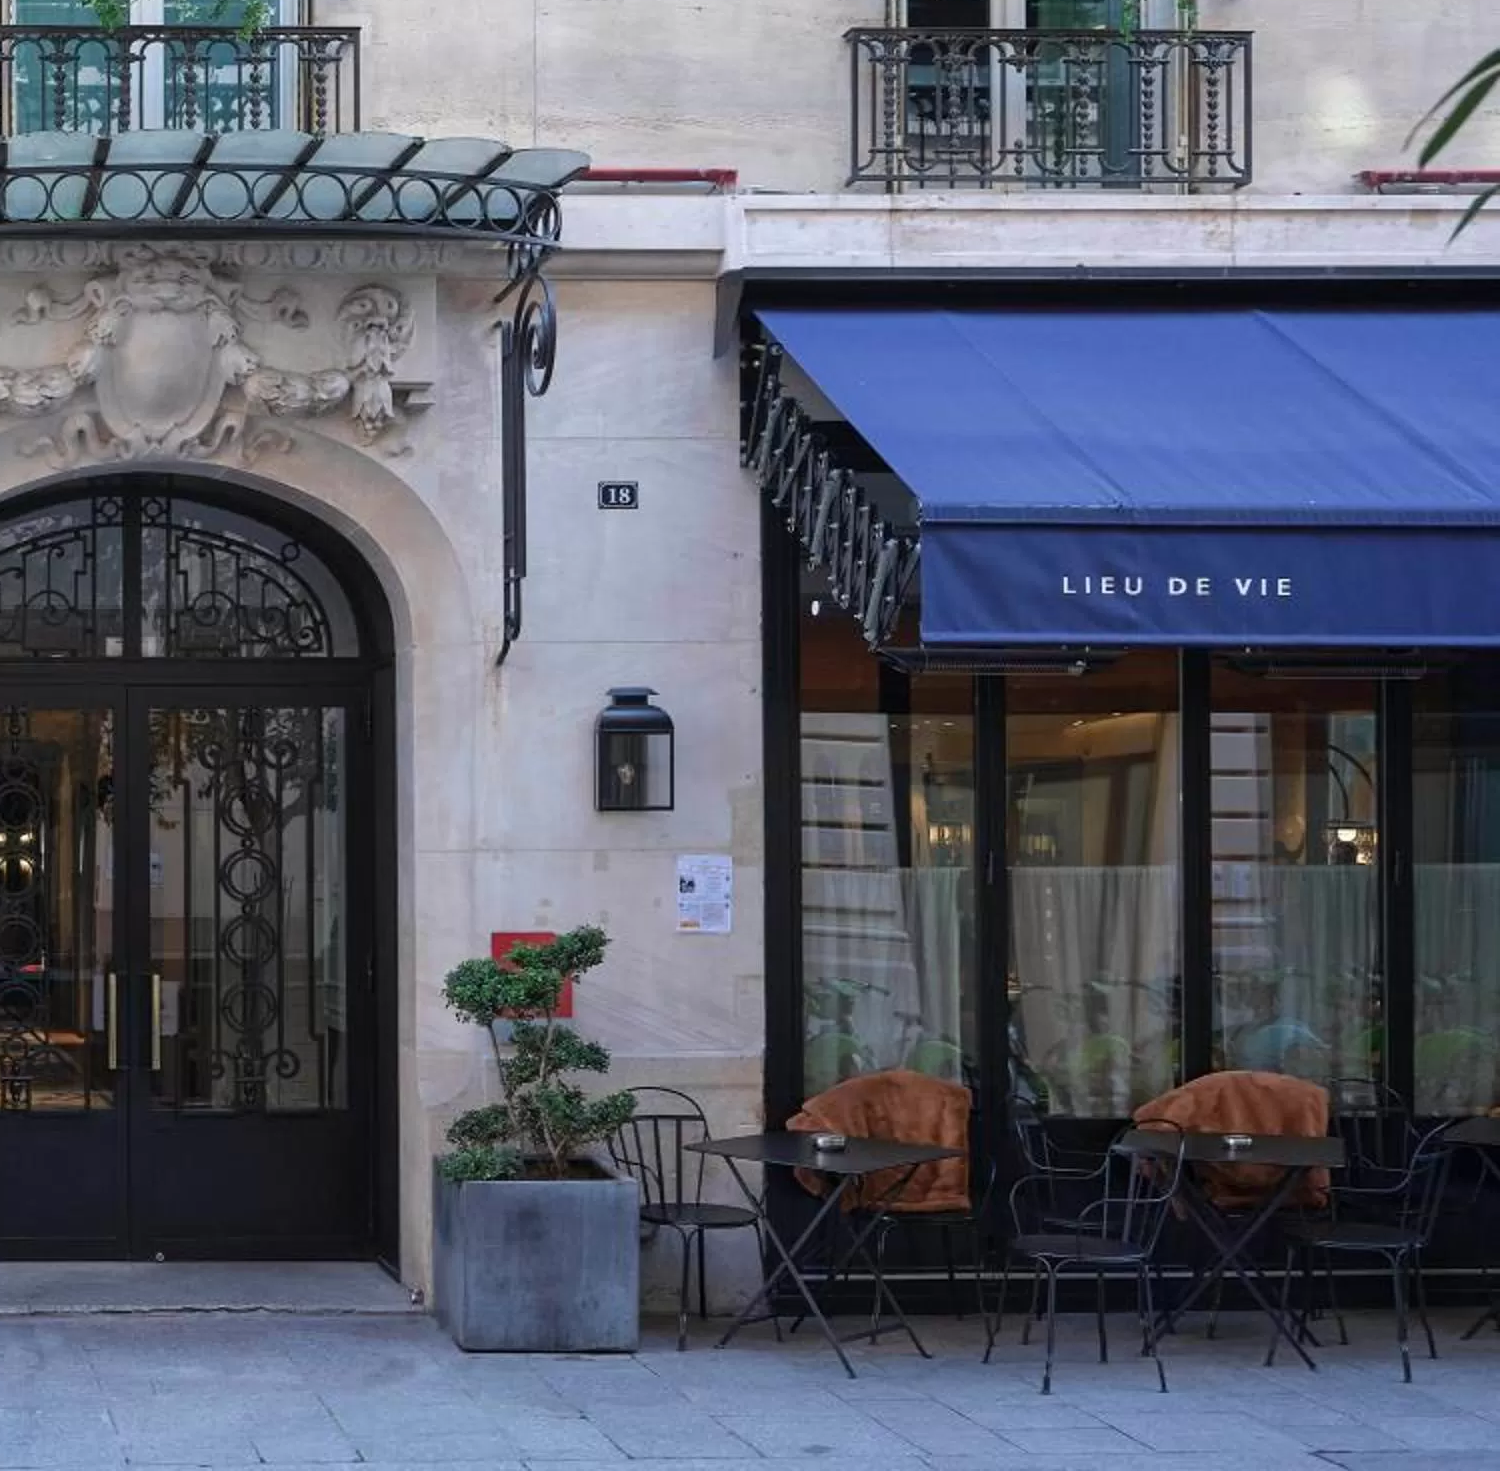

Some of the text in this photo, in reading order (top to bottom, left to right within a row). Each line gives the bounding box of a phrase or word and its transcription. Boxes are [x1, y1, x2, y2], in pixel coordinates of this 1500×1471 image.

[608, 487, 631, 504] 18
[1062, 576, 1293, 597] LIEU DE VIE
